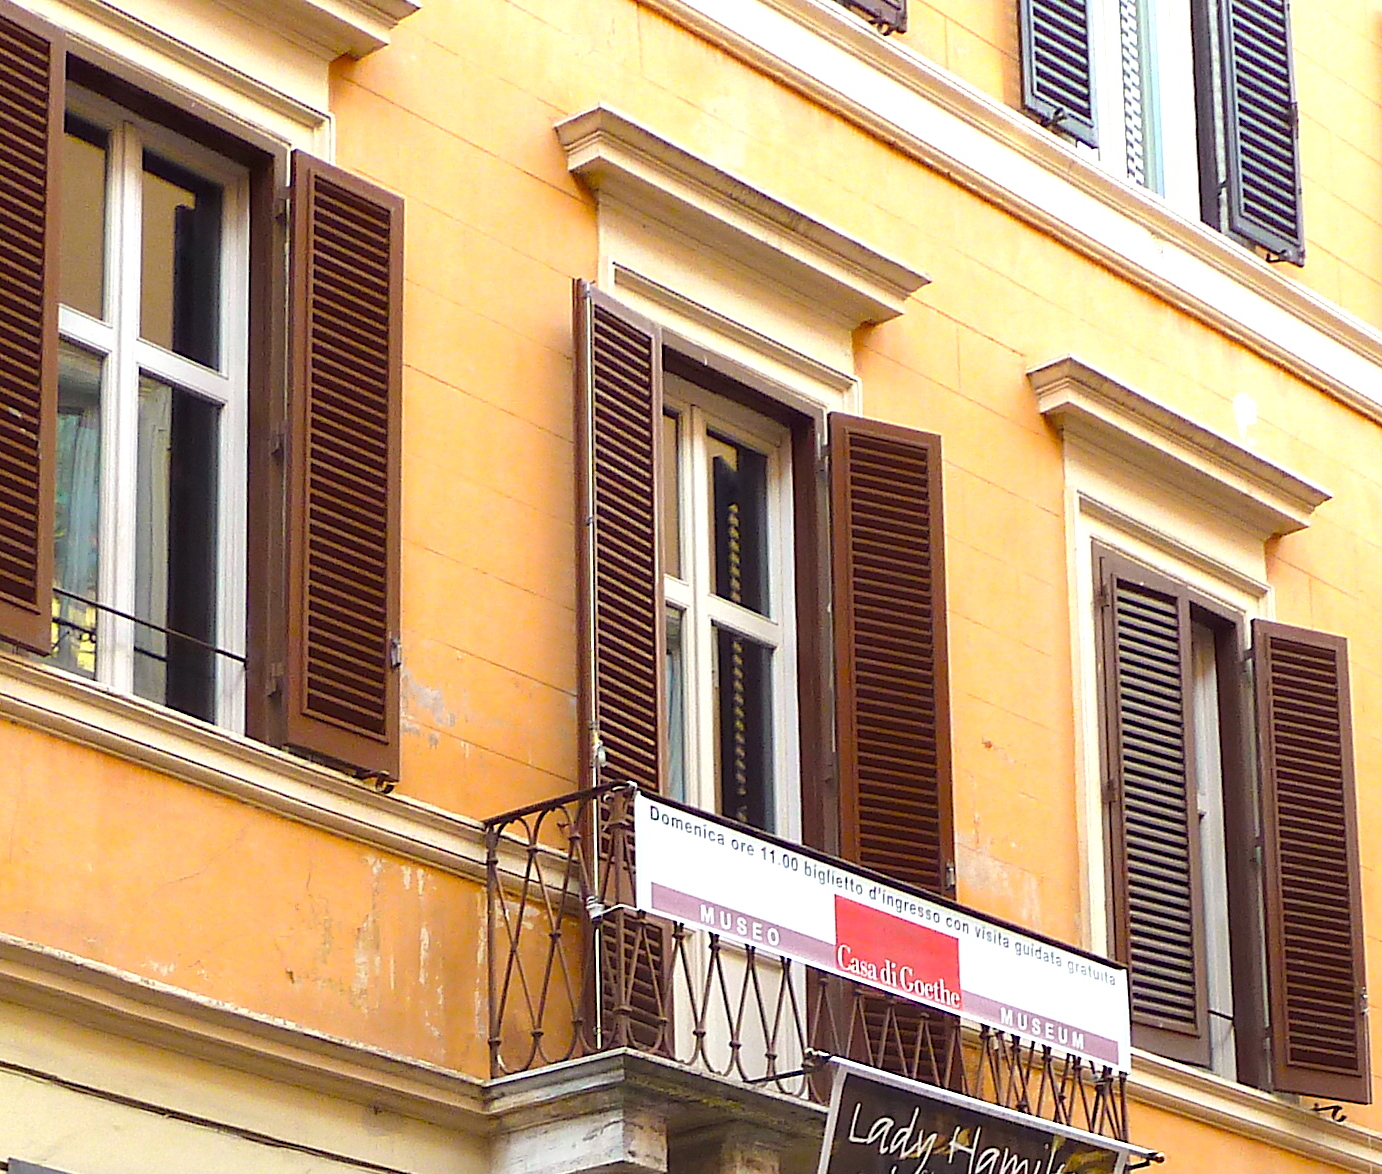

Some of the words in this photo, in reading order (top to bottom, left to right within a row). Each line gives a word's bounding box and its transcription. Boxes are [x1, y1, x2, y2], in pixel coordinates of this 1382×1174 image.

[650, 805, 725, 847] Domenica
[731, 836, 755, 856] ore
[760, 846, 799, 871] 11.00
[804, 859, 863, 896] biglietto
[868, 879, 940, 923] d'ingresso
[946, 912, 970, 935] con
[975, 921, 1009, 948] visita
[1014, 936, 1062, 967] guidata
[1067, 956, 1117, 986] gratuita
[699, 903, 781, 947] MUSEO
[836, 943, 877, 981] Casa
[879, 958, 898, 988] di
[900, 967, 961, 1008] Goethe
[1000, 1006, 1086, 1051] MUSEUM
